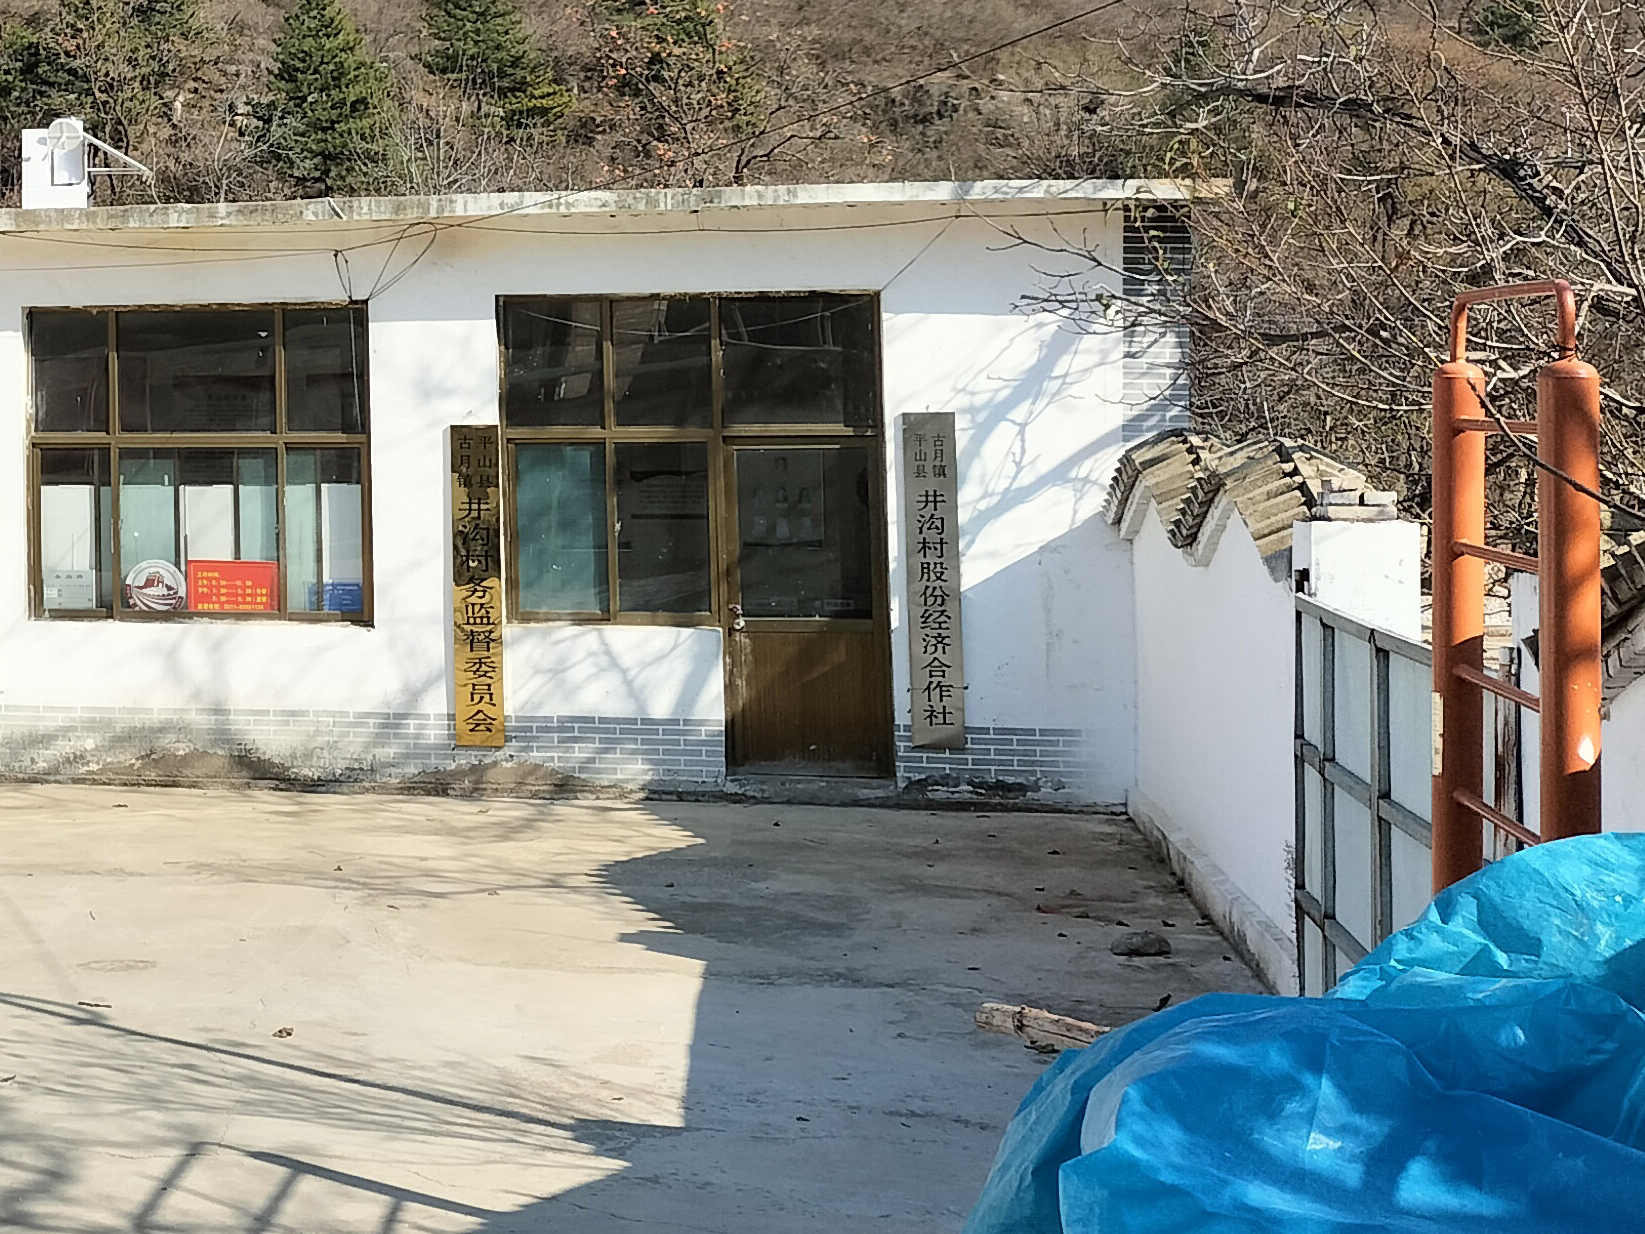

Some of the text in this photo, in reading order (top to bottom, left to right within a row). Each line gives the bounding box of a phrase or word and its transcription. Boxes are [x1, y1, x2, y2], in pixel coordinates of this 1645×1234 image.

[913, 432, 928, 479] 平山县
[457, 496, 498, 734] 井沟村务监督委员会
[915, 489, 956, 727] 井沟村股份经济合作社
